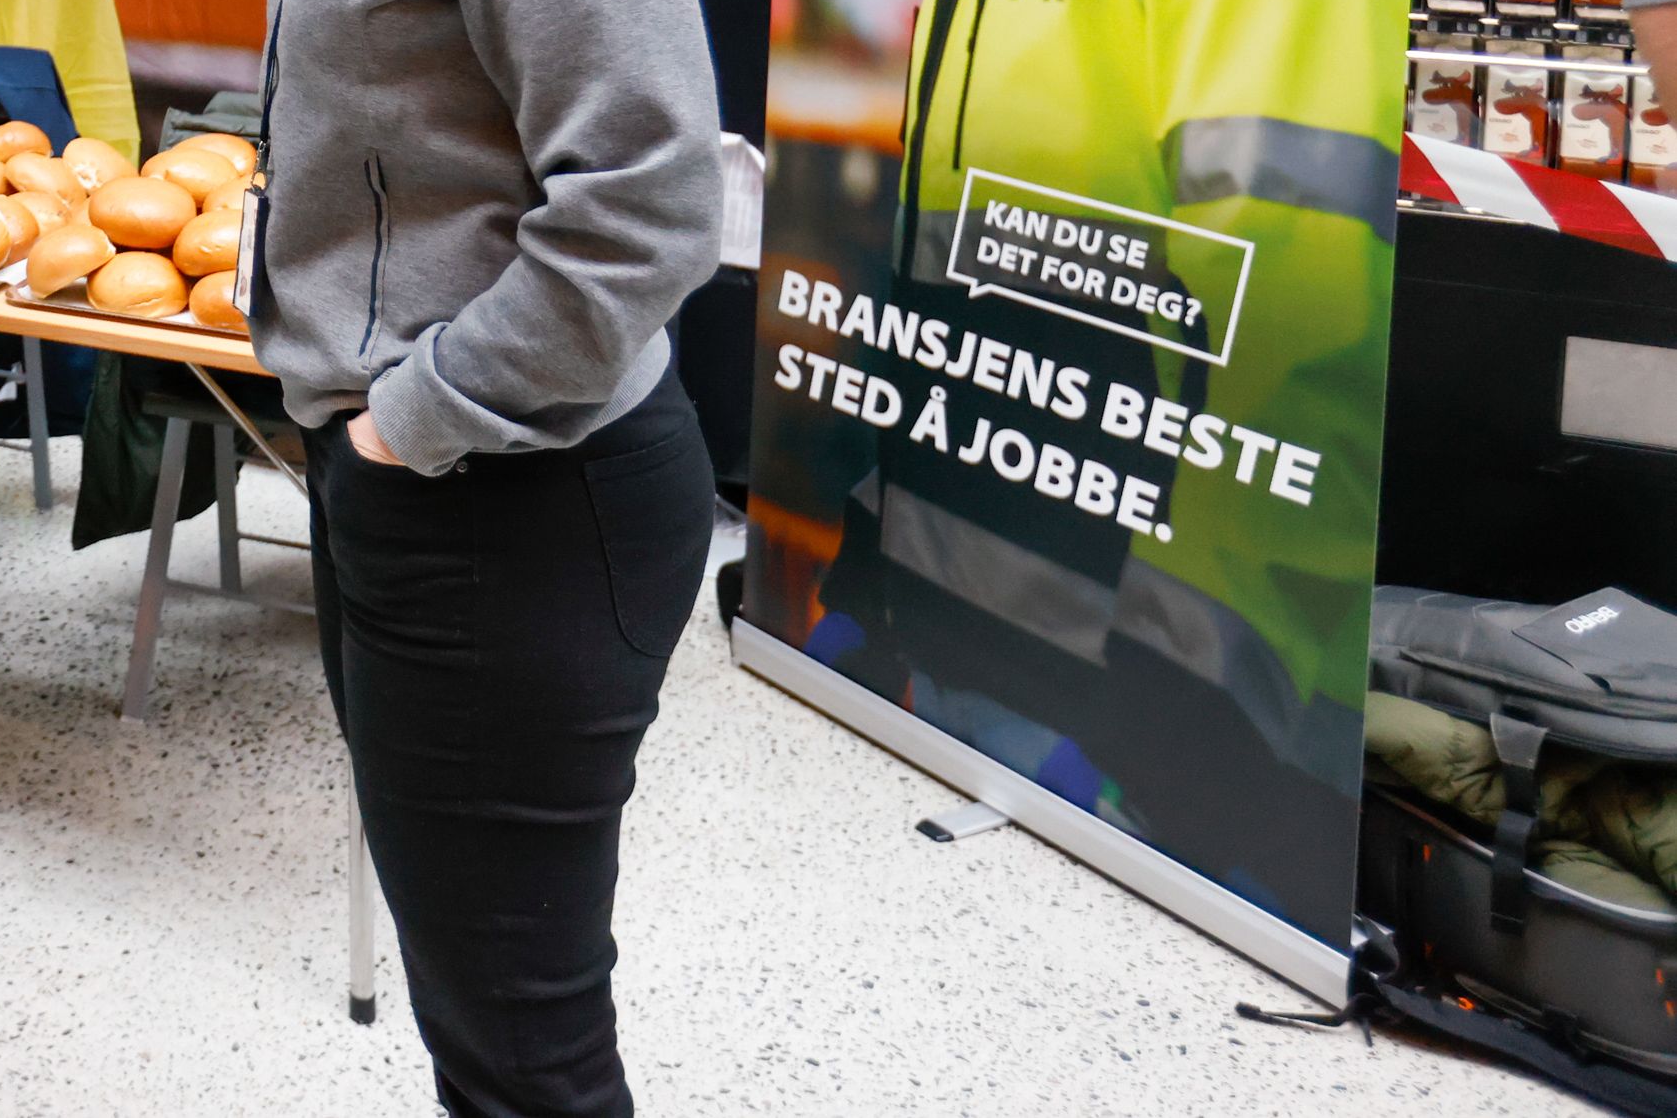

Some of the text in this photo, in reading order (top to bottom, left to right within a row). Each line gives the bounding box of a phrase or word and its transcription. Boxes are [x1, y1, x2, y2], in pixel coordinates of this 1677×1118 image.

[976, 236, 1203, 327] DET FOR DEG?
[984, 199, 1150, 270] KAN DU SE
[774, 344, 1174, 543] STED Å JOBBE.
[778, 269, 1322, 507] BRANSJENS BESTE
